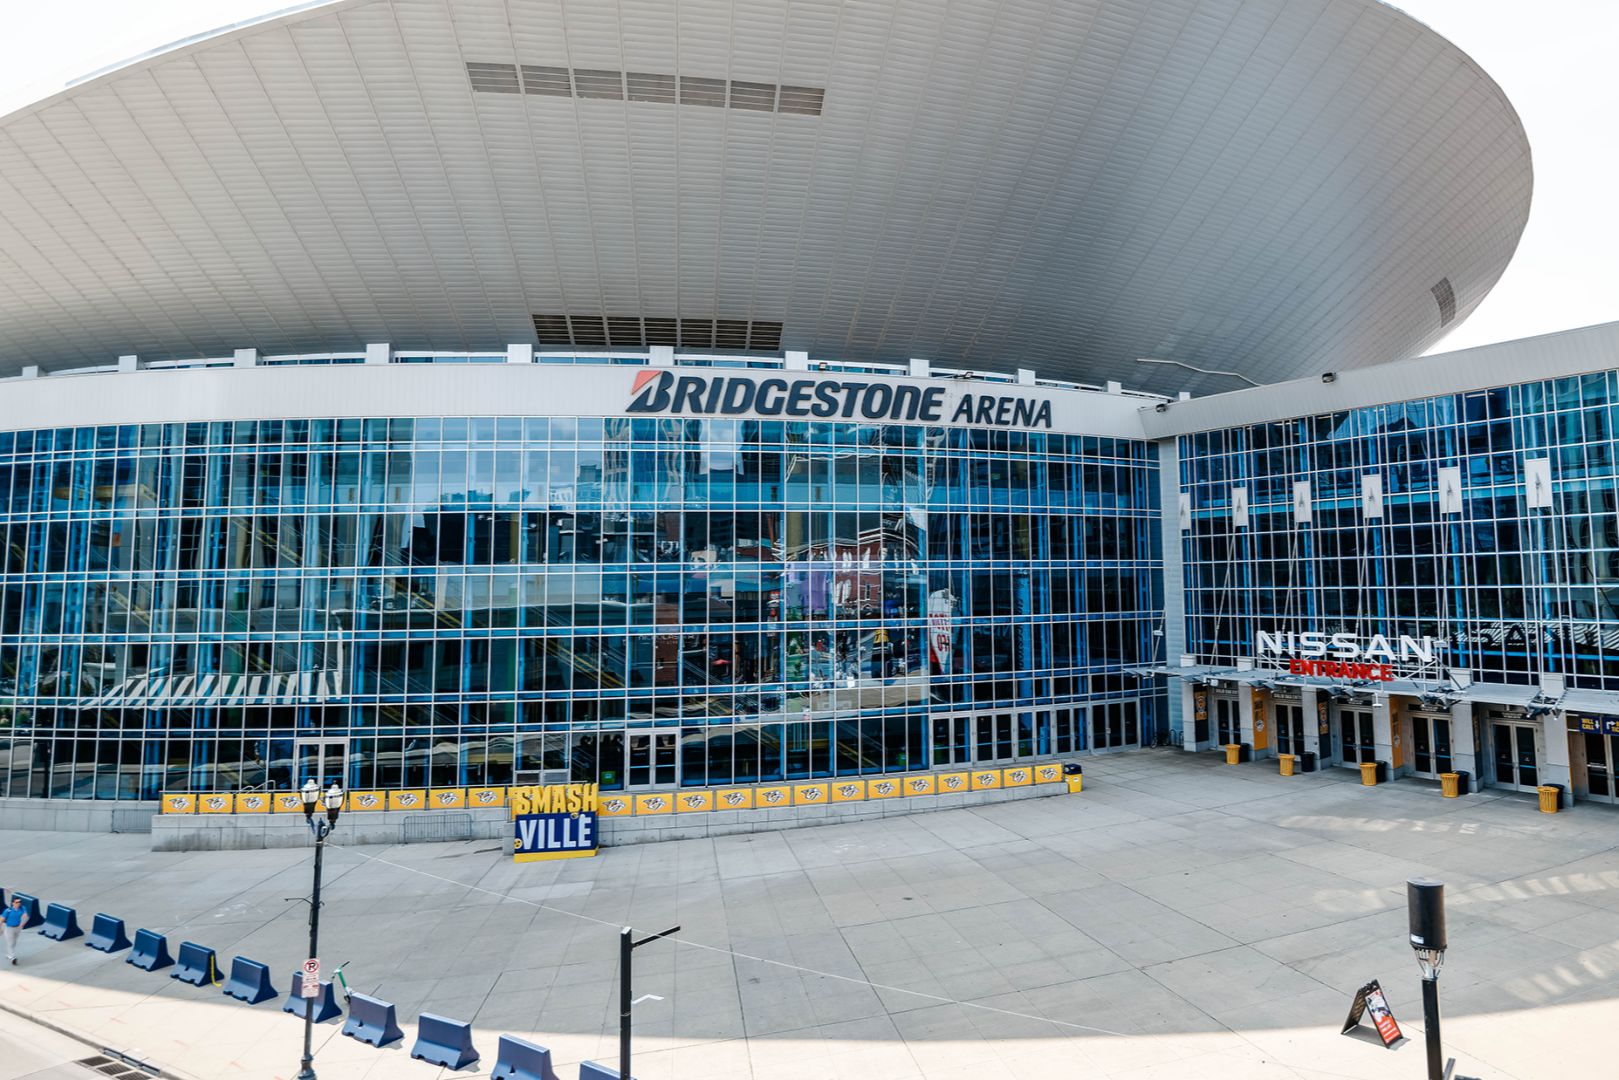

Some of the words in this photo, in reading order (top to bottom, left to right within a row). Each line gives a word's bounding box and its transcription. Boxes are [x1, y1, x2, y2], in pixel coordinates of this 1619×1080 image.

[625, 369, 946, 422] BRIDGESTONE
[952, 393, 1053, 428] ARENA
[1256, 630, 1433, 663] NISSAN
[1289, 659, 1394, 682] ENTRANCE
[516, 783, 599, 814] SMASH
[518, 815, 592, 850] VILLE
